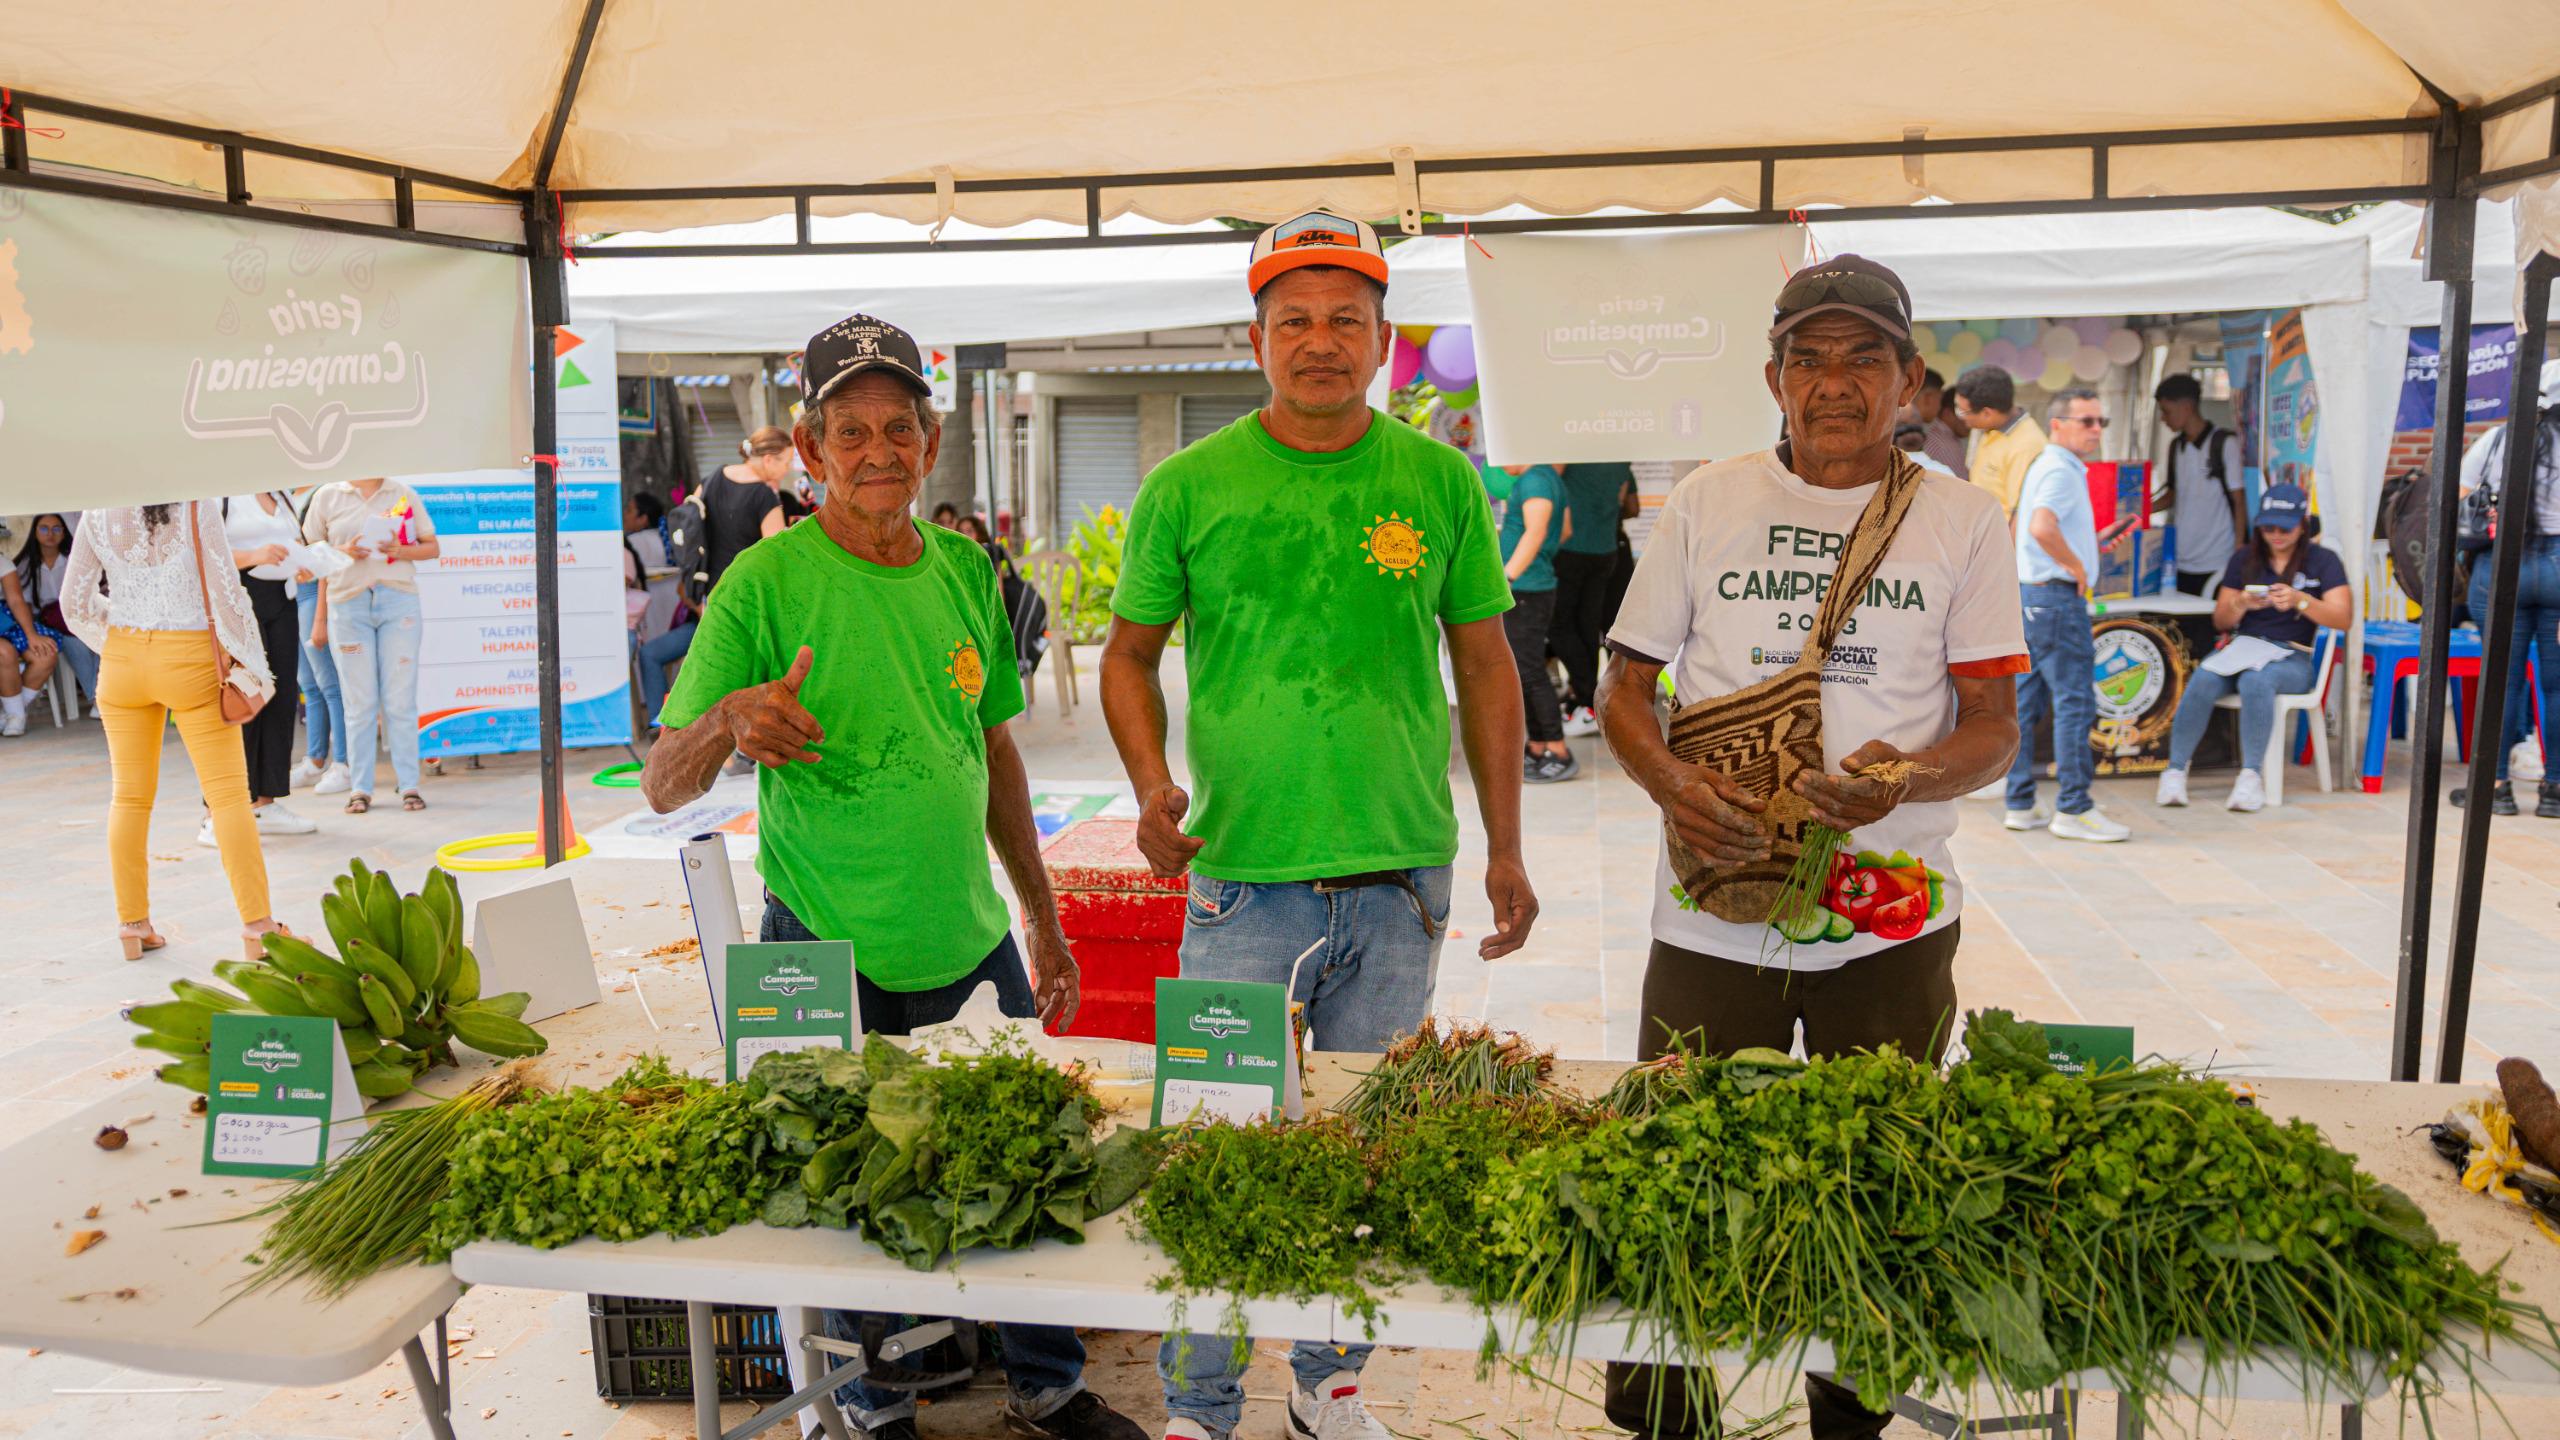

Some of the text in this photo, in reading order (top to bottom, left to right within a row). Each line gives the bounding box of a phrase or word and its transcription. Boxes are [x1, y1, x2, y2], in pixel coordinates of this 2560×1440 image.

[1296, 230, 1335, 244] KTM
[440, 555, 504, 568] PRIMERA
[1717, 570, 1926, 612] CAMPEINA
[1848, 646, 1878, 654] PACTO
[1839, 663, 1877, 672] SOLEDAD
[778, 965, 801, 975] Feria
[764, 974, 816, 985] Campesina
[810, 1011, 845, 1019] SOLEDAD
[1208, 1006, 1232, 1016] Feria
[1194, 1014, 1247, 1026] Campesina
[261, 1040, 284, 1051] Feria
[247, 1049, 298, 1060] Campesina
[2048, 1051, 2070, 1061] eria
[1241, 1059, 1278, 1067] SOLEDAD
[290, 1092, 326, 1100] SOLEDAD
